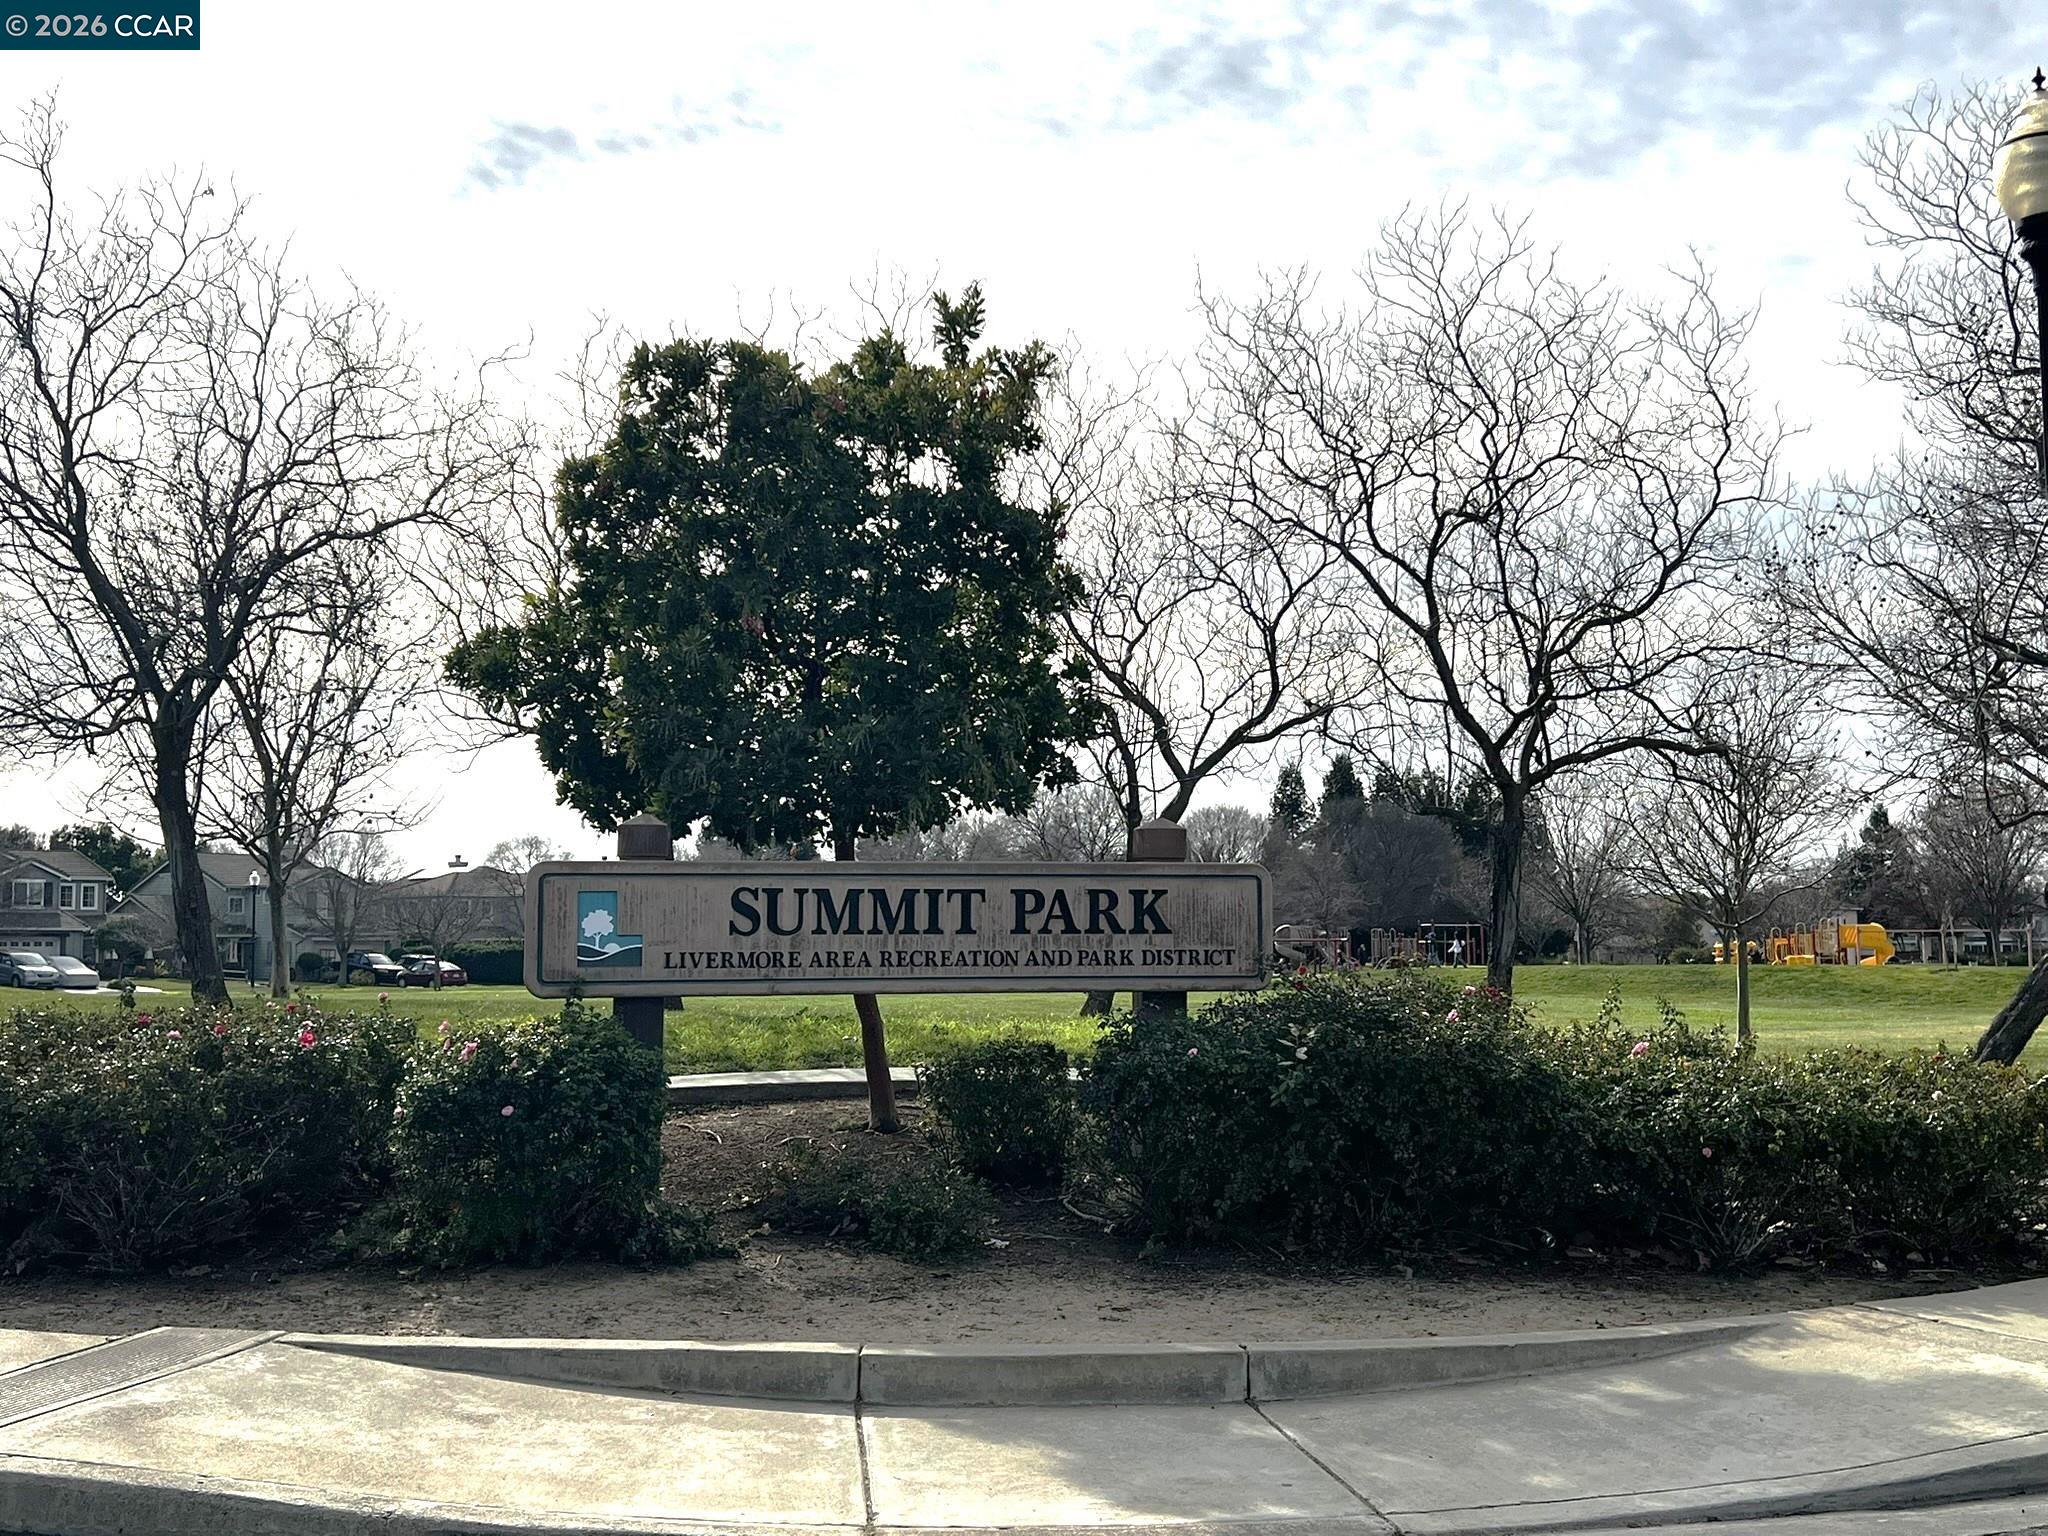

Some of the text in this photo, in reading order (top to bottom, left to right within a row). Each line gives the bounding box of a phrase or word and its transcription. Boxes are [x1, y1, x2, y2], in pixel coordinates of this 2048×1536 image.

[729, 887, 1173, 936] SUMMIT PARK
[664, 949, 1235, 969] LIVERMORE AREA RECREATION AND PARK DISTRICT
